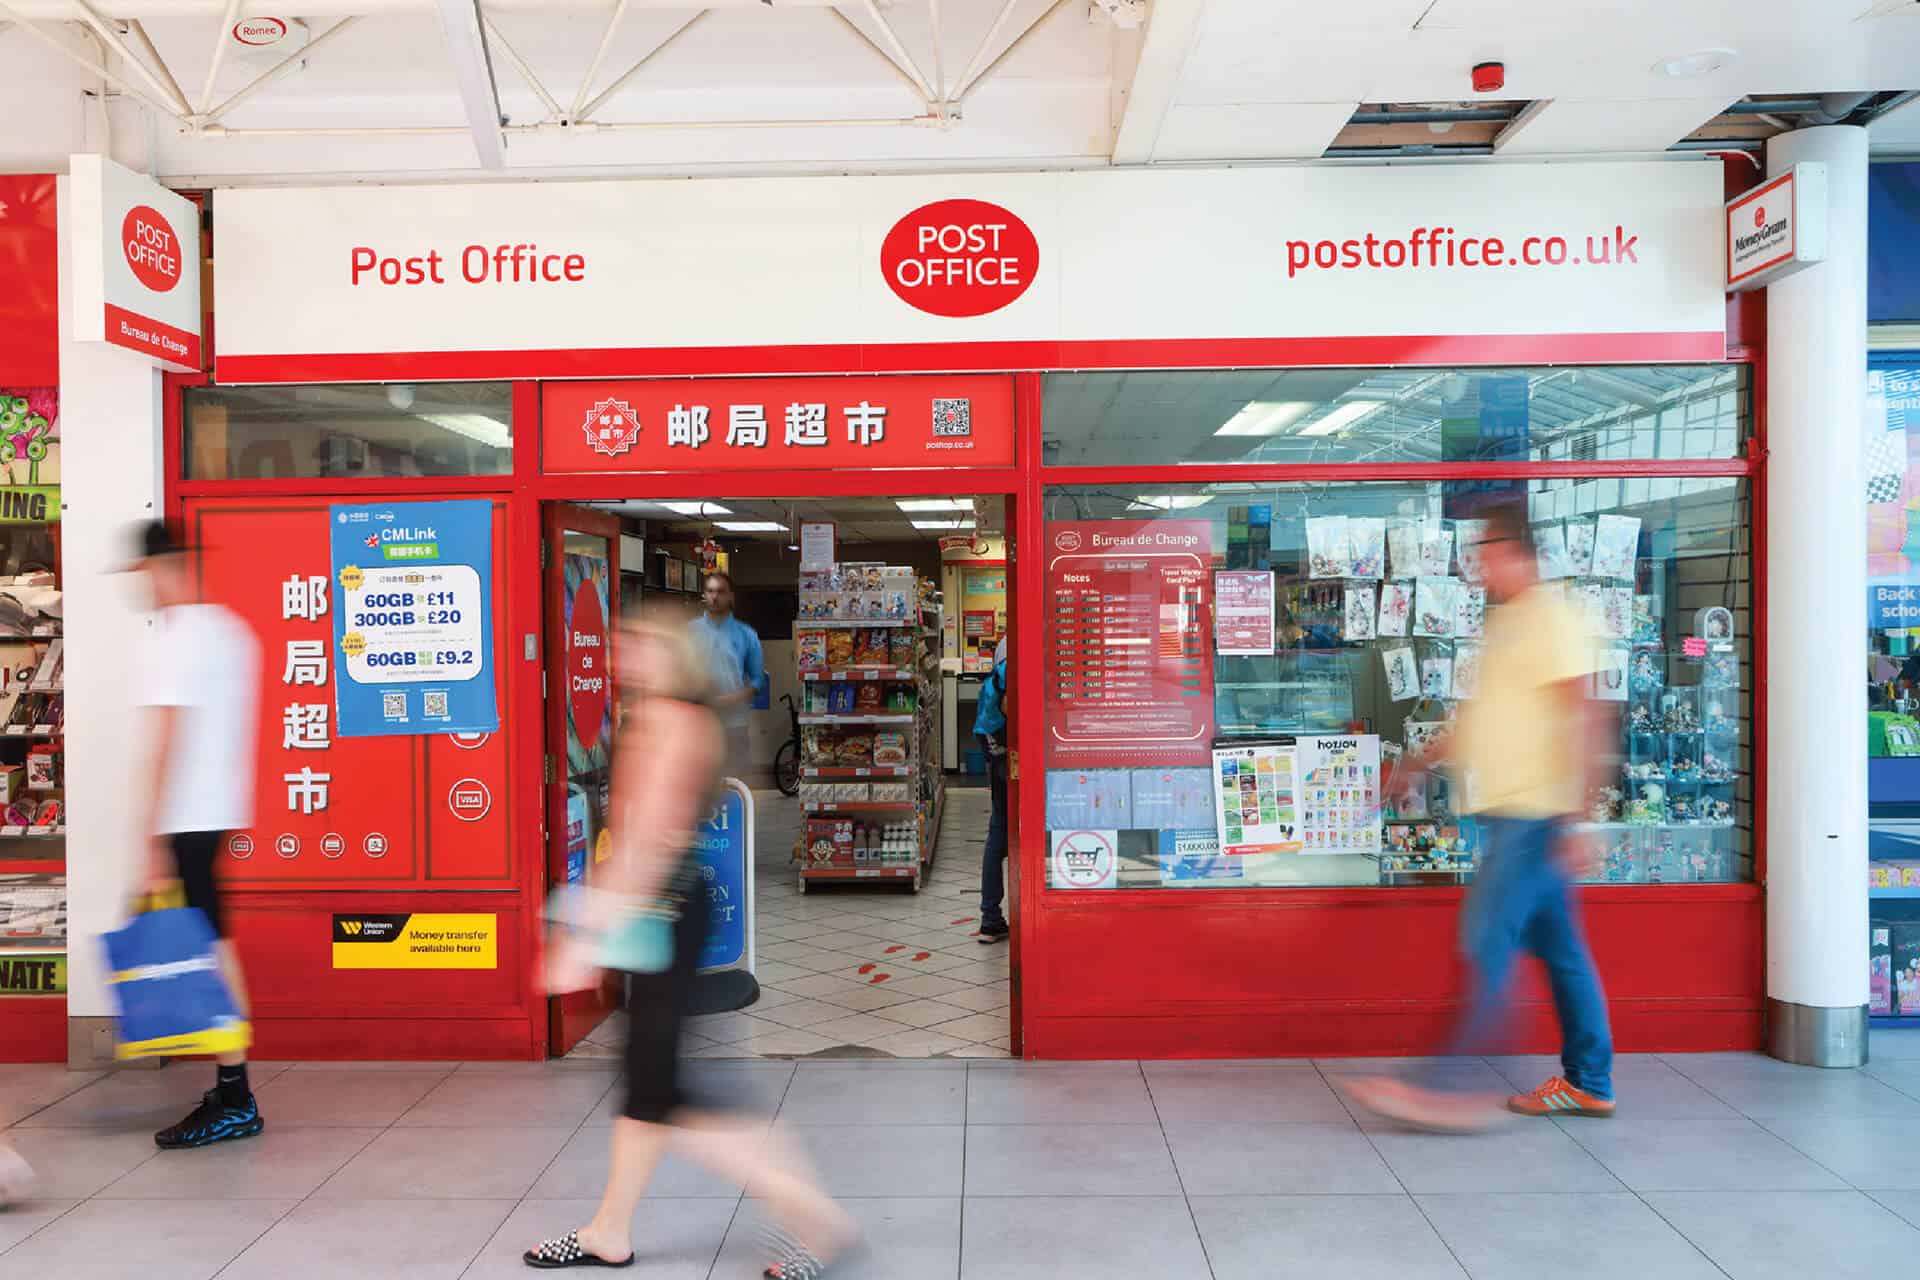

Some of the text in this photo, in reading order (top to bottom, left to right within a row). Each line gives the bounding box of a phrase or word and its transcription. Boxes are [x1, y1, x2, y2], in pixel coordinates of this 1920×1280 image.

[243, 26, 277, 36] Romec
[136, 219, 171, 252] POST
[917, 223, 1008, 253] POST
[1735, 217, 1788, 253] MoneyGram
[128, 240, 177, 278] OFFICE
[1286, 224, 1640, 279] postoffice.co.uk
[351, 243, 586, 287] Post Office
[896, 257, 1020, 288] OFFICE
[120, 320, 189, 356] Bureau de Change
[667, 400, 887, 448] 邮局超市
[0, 490, 47, 521] ING
[381, 528, 437, 542] CMLink
[1092, 532, 1199, 547] Bureau de Change
[1063, 573, 1090, 583] Notes
[364, 591, 454, 608] 60GB £11
[1877, 587, 1916, 601] Back
[354, 610, 462, 627] 300GB £20
[573, 631, 601, 647] Bureau
[366, 651, 417, 667] 60GB
[436, 650, 473, 665] £9.2
[582, 652, 593, 669] de
[573, 675, 603, 693] Change
[282, 574, 331, 815] 邮局超市
[363, 921, 393, 930] Western
[363, 928, 385, 936] Union
[410, 930, 489, 942] Money transfer
[410, 944, 481, 953] available here
